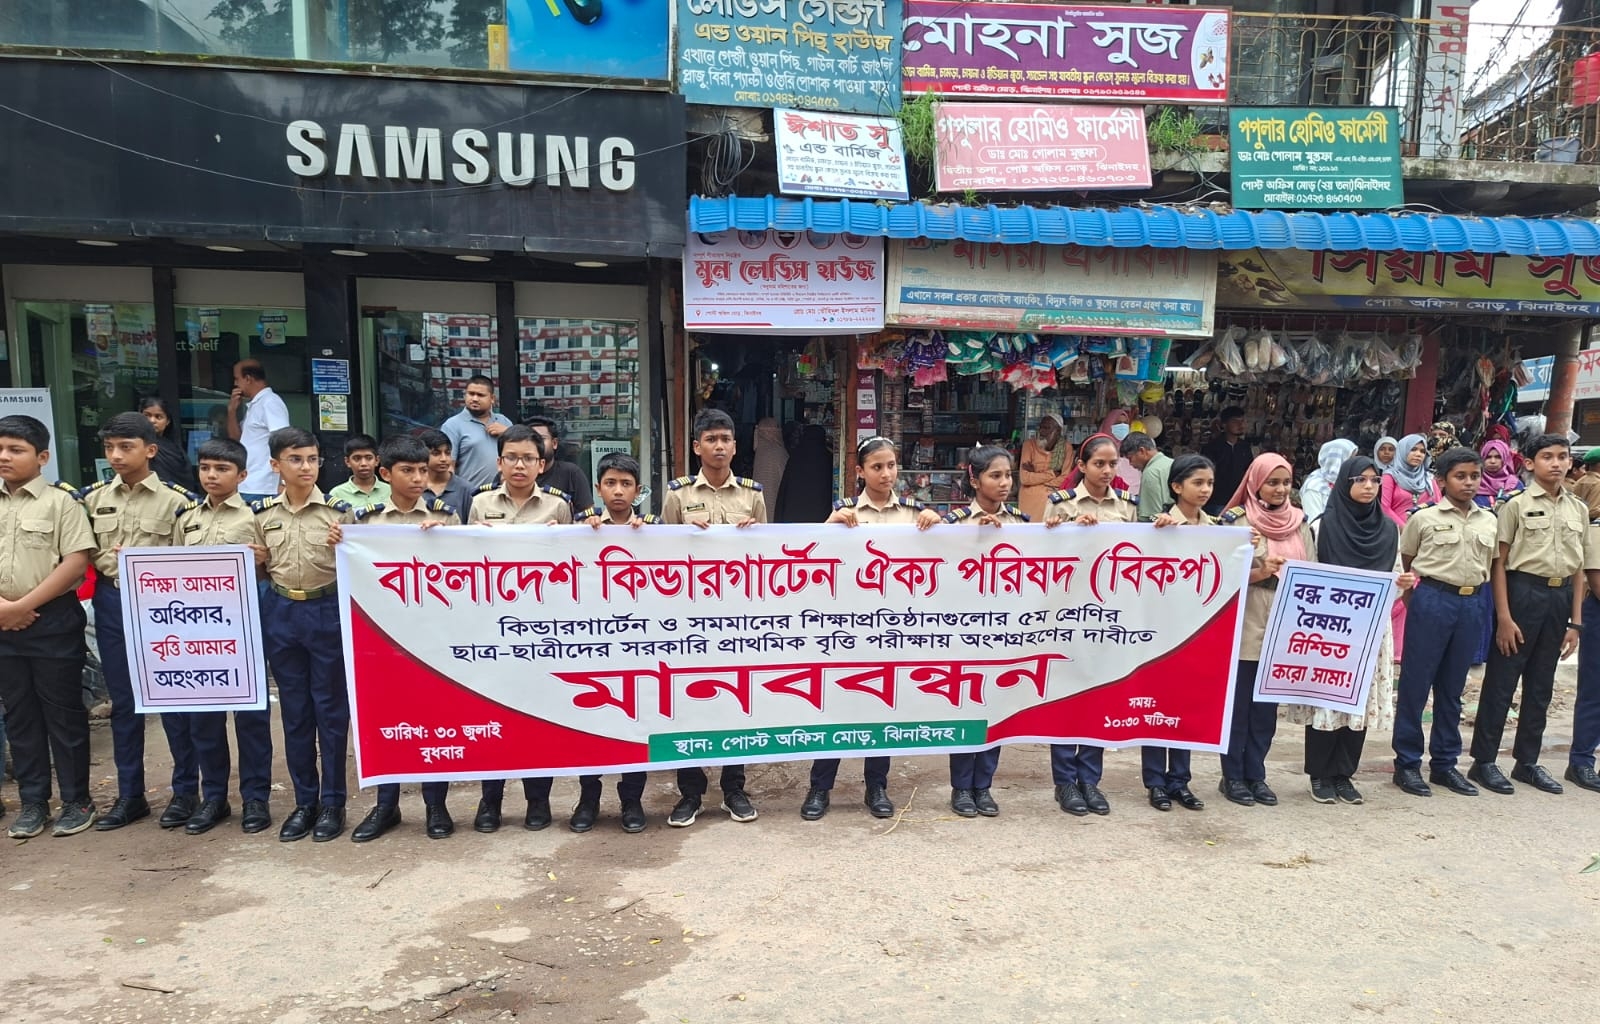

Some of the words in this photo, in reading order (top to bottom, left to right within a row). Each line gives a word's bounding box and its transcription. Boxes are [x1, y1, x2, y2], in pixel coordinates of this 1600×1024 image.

[735, 24, 786, 45] ওয়ান
[832, 27, 893, 54] হাউজ
[902, 13, 1077, 62] মোহনা
[1087, 21, 1190, 69] সুজ
[682, 47, 715, 67] এখানে
[833, 78, 865, 95] পাওয়া
[1009, 108, 1069, 144] হোমিও
[1238, 117, 1286, 150] পপুলার
[1290, 111, 1336, 147] হোমিও
[286, 119, 636, 191] SAMSUNG
[800, 143, 827, 154] এন্ড
[1032, 147, 1066, 160] গোলাম
[1271, 151, 1302, 162] গোলাম
[953, 177, 1006, 186] মোবাইল
[1032, 163, 1062, 174] অফিস
[1266, 178, 1294, 191] অফিস
[694, 259, 732, 288] মুন
[739, 253, 810, 285] লেডিস
[816, 256, 877, 282] হাউজ
[907, 291, 932, 300] এখানে
[934, 292, 953, 302] সকল
[955, 293, 977, 303] প্রকার
[979, 292, 1011, 304] মোবাইল
[1069, 295, 1083, 307] বিল
[1086, 299, 1092, 307] ও
[1163, 302, 1178, 312] করা
[1517, 301, 1591, 313] ঝিনাইদহ
[138, 572, 177, 594] শিক্ষা
[182, 576, 235, 592] আমার
[373, 554, 586, 608] বাংলাদেশ
[593, 541, 843, 605] কিন্ডারগার্টেন
[855, 539, 946, 599] ঐক্য
[957, 542, 1082, 599] পরিষদ
[1090, 541, 1222, 606] (বিকপ)
[1293, 583, 1325, 605] বন্ধ
[1330, 587, 1376, 610] করো
[148, 600, 231, 626] অধিকার,
[496, 612, 652, 638] কিন্ডারগার্টেন
[658, 617, 678, 632] ও
[686, 614, 793, 633] সমমানের
[799, 607, 1011, 630] শিক্ষাপ্রতিষ্ঠানগুলোর
[1017, 609, 1049, 626] ৫ম
[1055, 602, 1122, 623] শ্রেণির
[1297, 605, 1352, 636] বৈষম্য,
[151, 635, 181, 662] বৃত্তি
[184, 639, 237, 655] আমার
[450, 637, 613, 663] ছাত্র-ছাত্রীদের
[621, 635, 710, 658] সরকারি
[717, 632, 806, 654] প্রাথমিক
[814, 631, 856, 657] বৃত্তি
[865, 629, 955, 651] পরীক্ষায়
[961, 628, 1074, 649] অংশগ্রহণের
[1082, 624, 1158, 646] দাবীতে
[1287, 631, 1350, 659] নিশ্চিত
[549, 652, 1076, 722] মানববন্ধন
[1272, 663, 1308, 684] করো
[1311, 667, 1352, 689] সাম্য!
[434, 726, 457, 738] ৩০
[461, 719, 502, 742] জুলাই
[1143, 711, 1181, 729] ঘটিকা
[721, 731, 771, 751] পোস্ট
[775, 728, 827, 747] অফিস
[832, 729, 877, 748] মোড়,
[882, 724, 955, 744] ঝিনাইদহ
[419, 744, 465, 763] বুধবার
